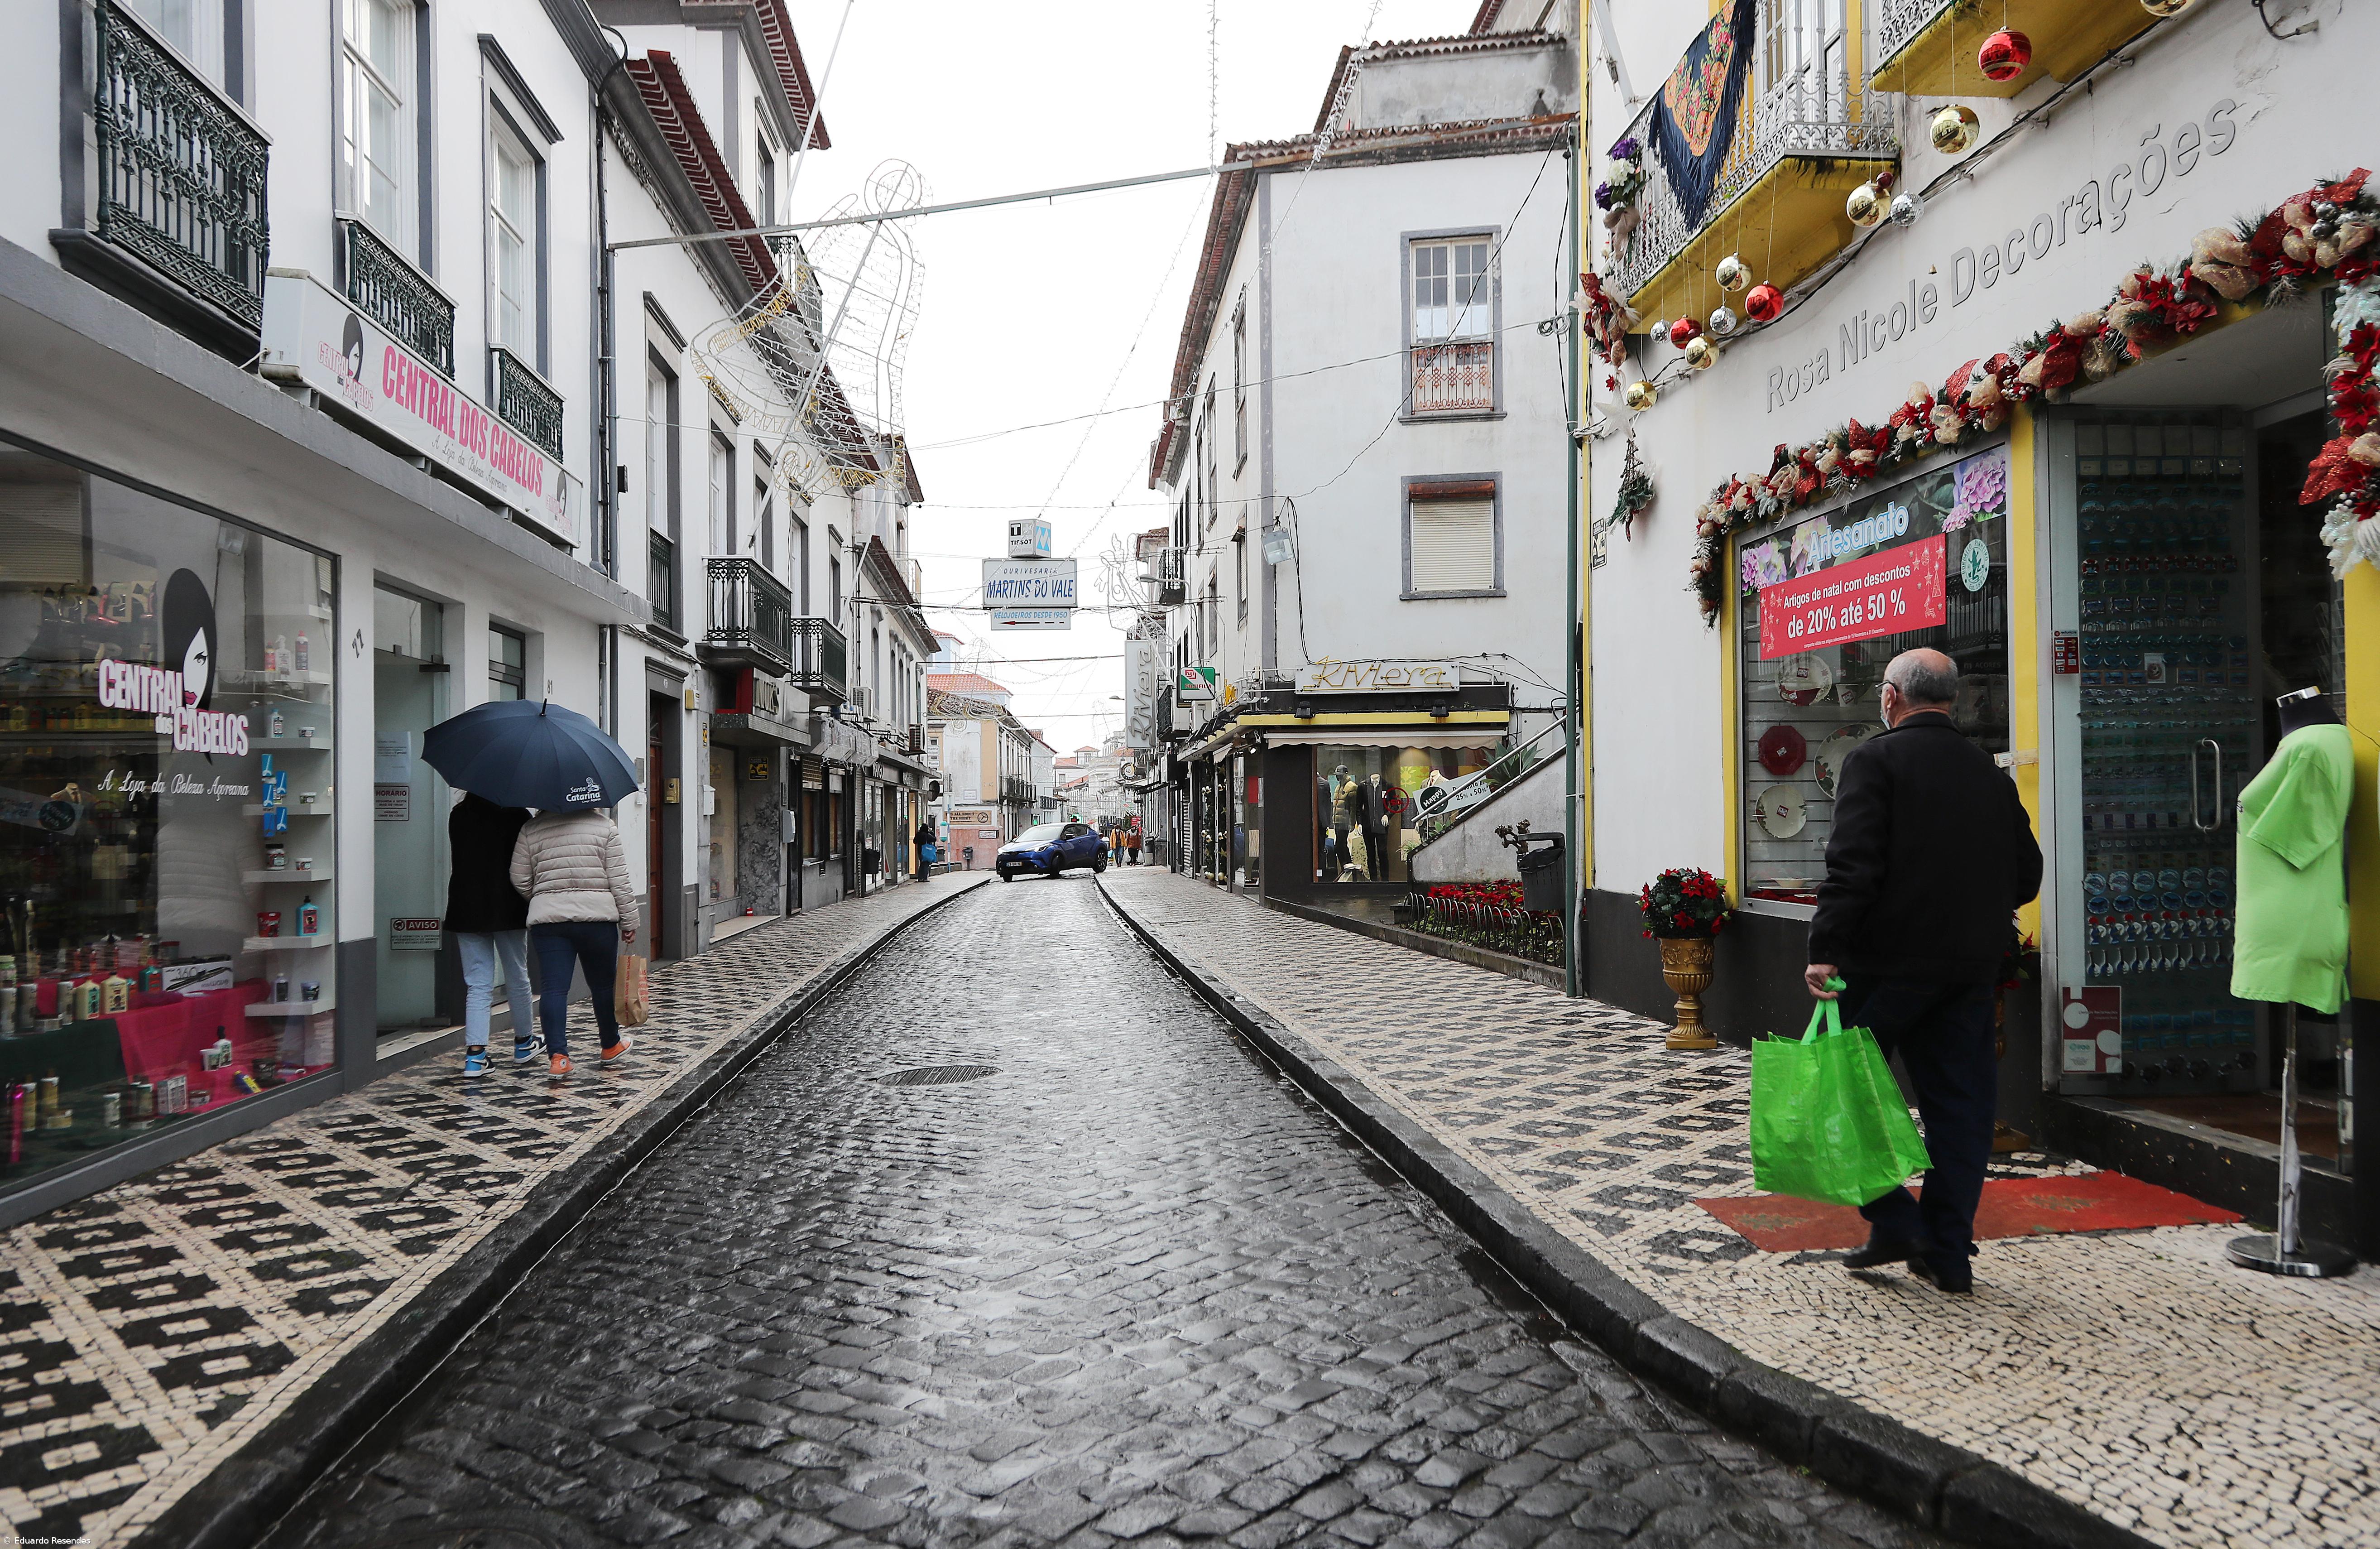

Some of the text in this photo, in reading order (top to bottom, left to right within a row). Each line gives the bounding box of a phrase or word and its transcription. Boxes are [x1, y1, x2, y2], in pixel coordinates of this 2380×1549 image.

[1766, 98, 2237, 413] Rosa Nicole Decorações
[318, 341, 349, 376] CENTRAL
[344, 375, 373, 411] CABELOS
[383, 345, 542, 497] CENTRAL DOS CABELOS
[432, 434, 440, 449] A
[442, 440, 455, 464] Loja
[458, 450, 465, 466] da
[468, 455, 484, 478] Beleza
[1807, 501, 1909, 566] Artesanato
[986, 579, 1073, 598] MARTINS DO VALE
[1783, 564, 1911, 610] Artigos de natal com descontos
[1787, 587, 1906, 639] de 20% até 50 %
[352, 629, 364, 658] 77
[99, 659, 183, 715] CENTRAL
[547, 679, 552, 695] 81
[1128, 646, 1152, 746] Riviera
[155, 713, 173, 735] dos
[173, 706, 249, 757] CABELOS
[97, 769, 250, 802] A Loja da Beleza Açoreana
[566, 792, 600, 802] Catarina
[1423, 788, 1443, 807] Happy
[1473, 787, 1487, 795] 50%
